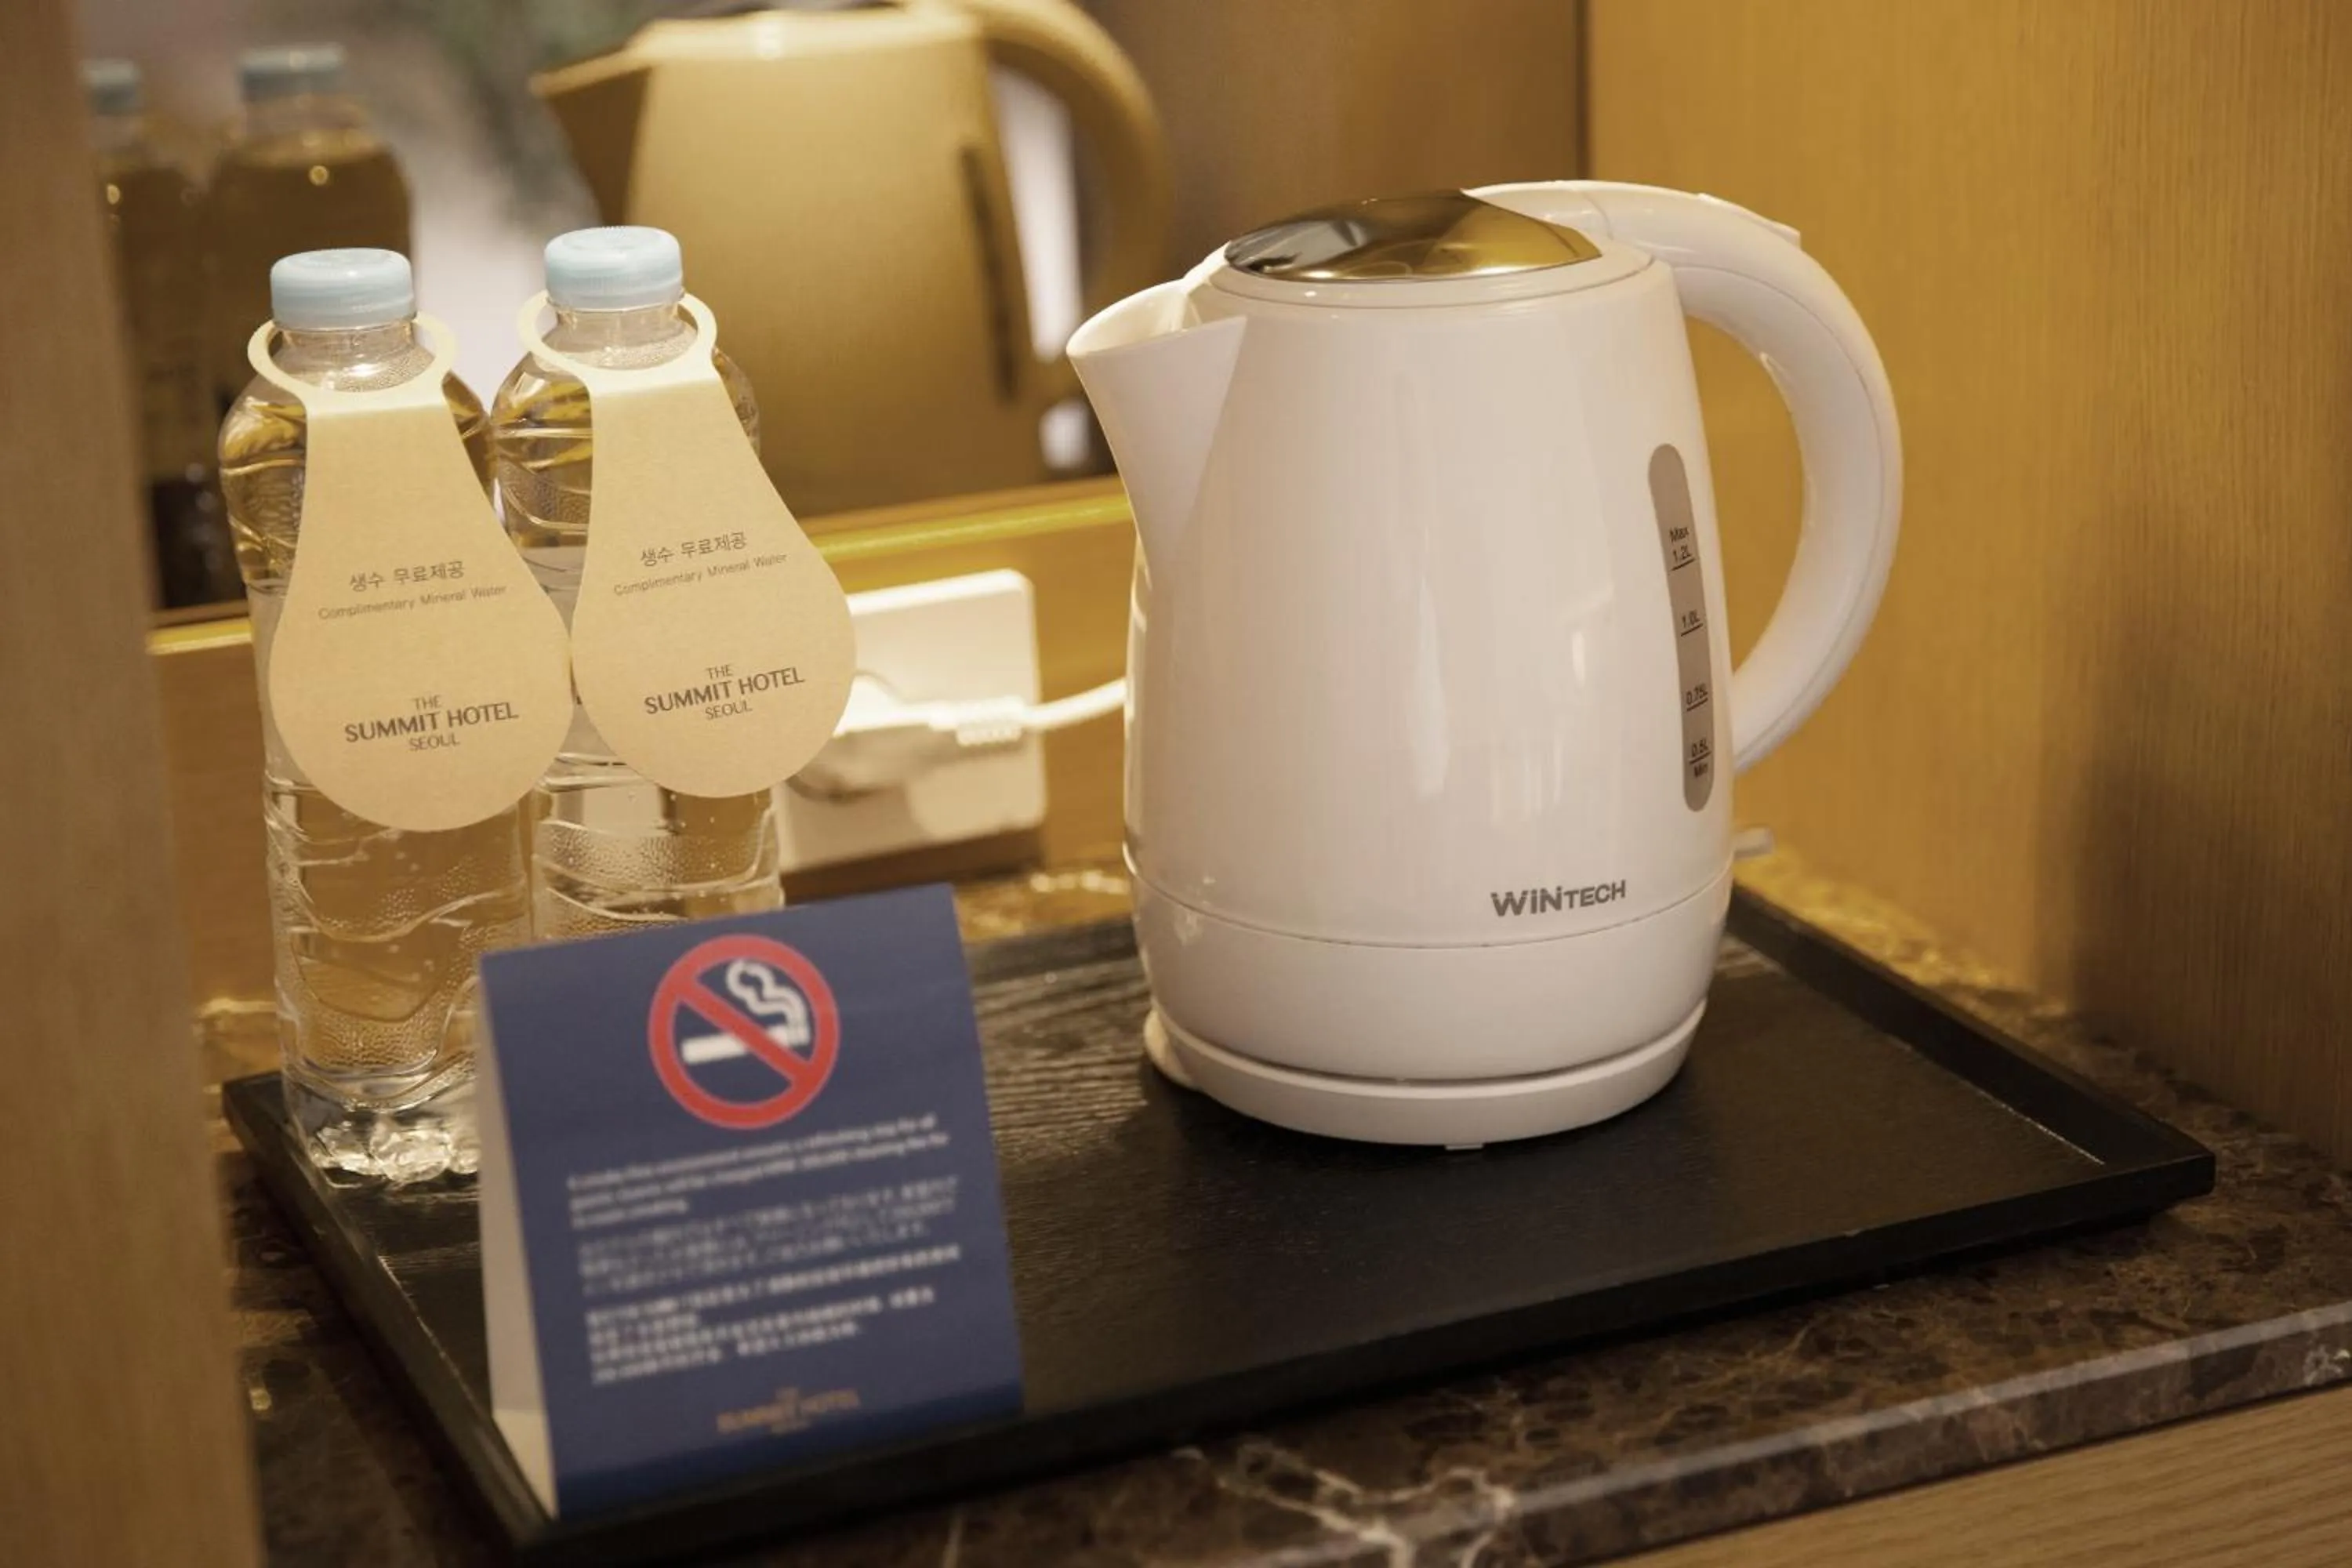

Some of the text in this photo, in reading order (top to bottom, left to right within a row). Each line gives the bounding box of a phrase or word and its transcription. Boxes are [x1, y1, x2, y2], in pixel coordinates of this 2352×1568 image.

[641, 532, 748, 567] 생수 무료제공
[350, 560, 466, 592] 생수 무료제공
[614, 553, 788, 596] Complimentary Mineral Water
[318, 585, 508, 619] Complimentary Mineral Water
[706, 664, 735, 680] THE
[412, 695, 443, 710] THE
[644, 666, 806, 714] SUMMIT HOTEL
[344, 702, 520, 743] SUMMIT HOTEL
[705, 700, 753, 720] SEOUL
[408, 732, 461, 752] SEOUL
